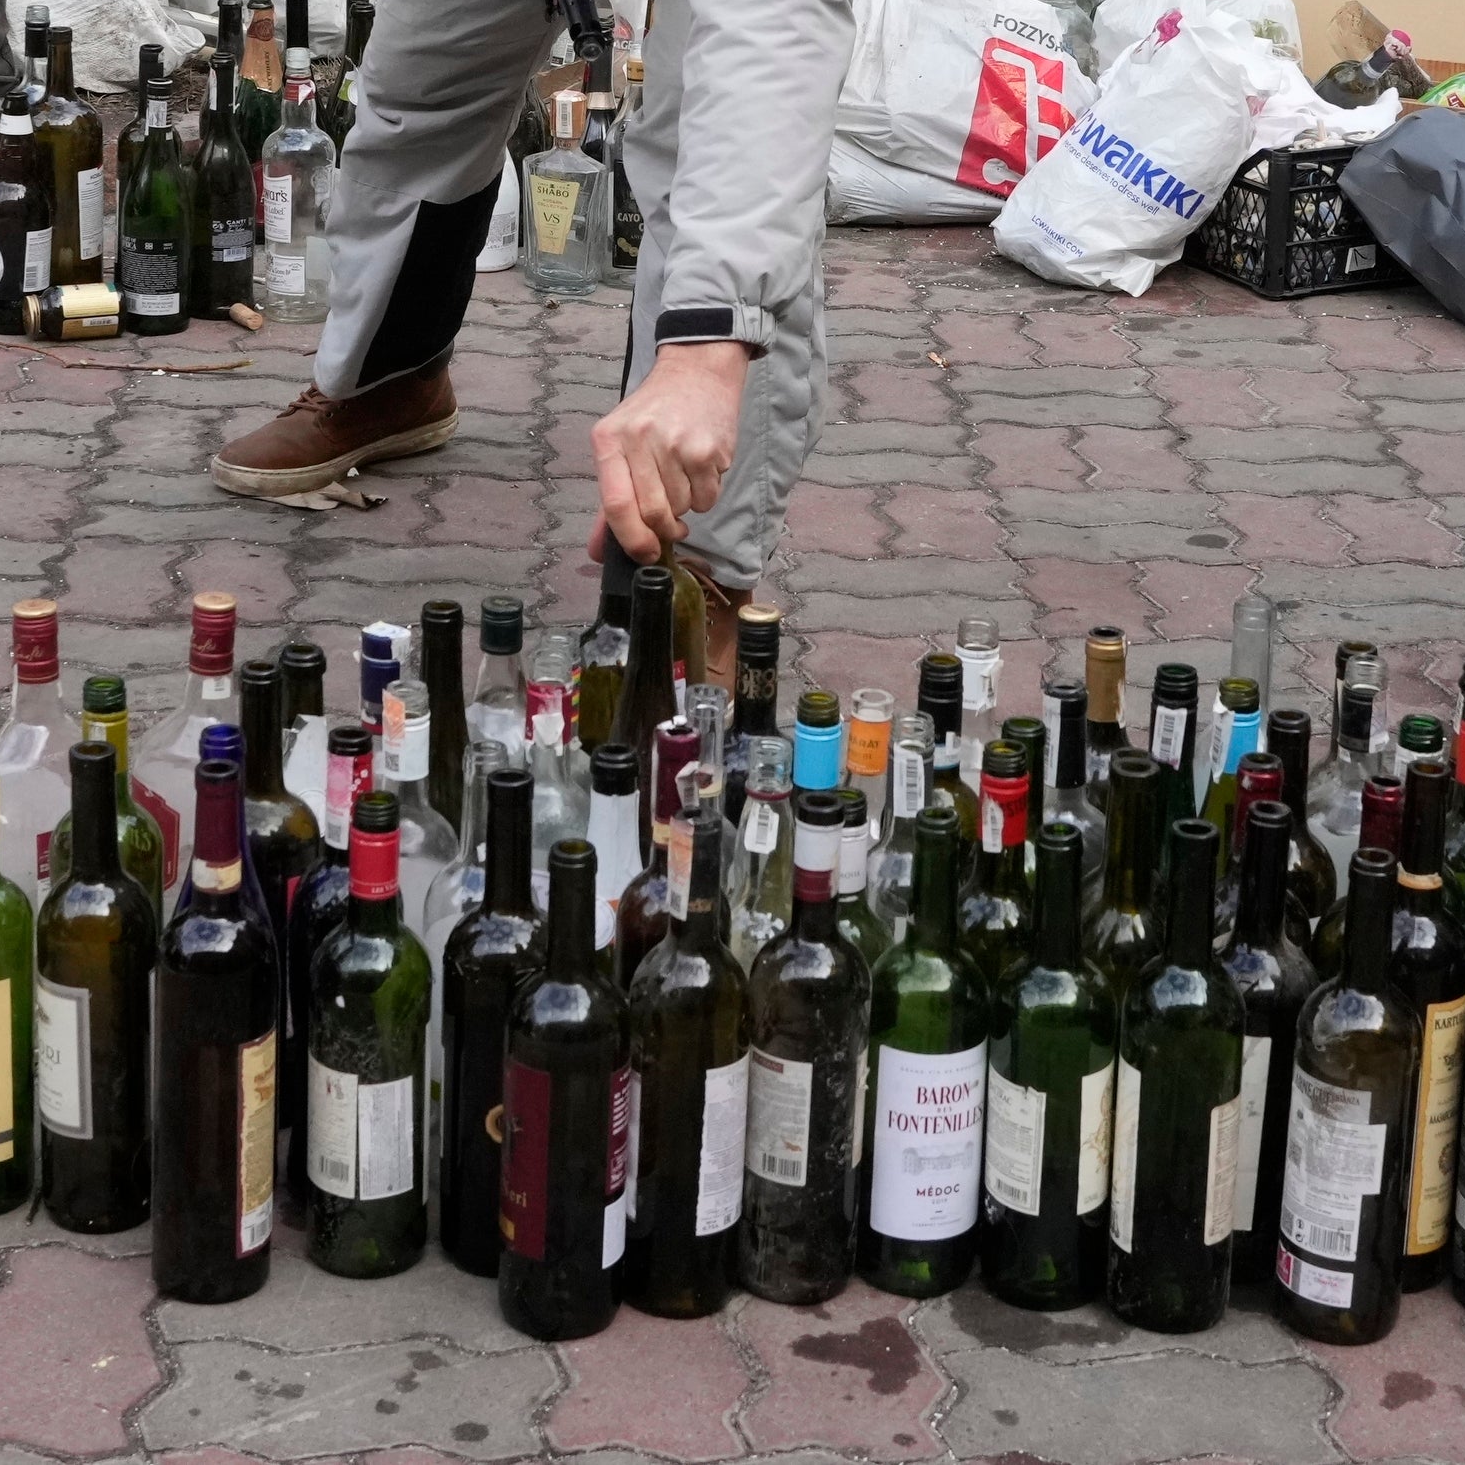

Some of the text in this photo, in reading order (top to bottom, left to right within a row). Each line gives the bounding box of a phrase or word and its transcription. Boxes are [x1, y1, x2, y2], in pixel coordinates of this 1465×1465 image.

[537, 186, 570, 198] SHABO
[1080, 155, 1110, 183] deserves
[1140, 200, 1161, 216] well
[543, 211, 561, 225] VS
[617, 212, 641, 224] CAYO
[1031, 214, 1083, 259] LCWAIKIKI.COM
[916, 1082, 971, 1105] BARON
[916, 1183, 961, 1198] MÉDOC
